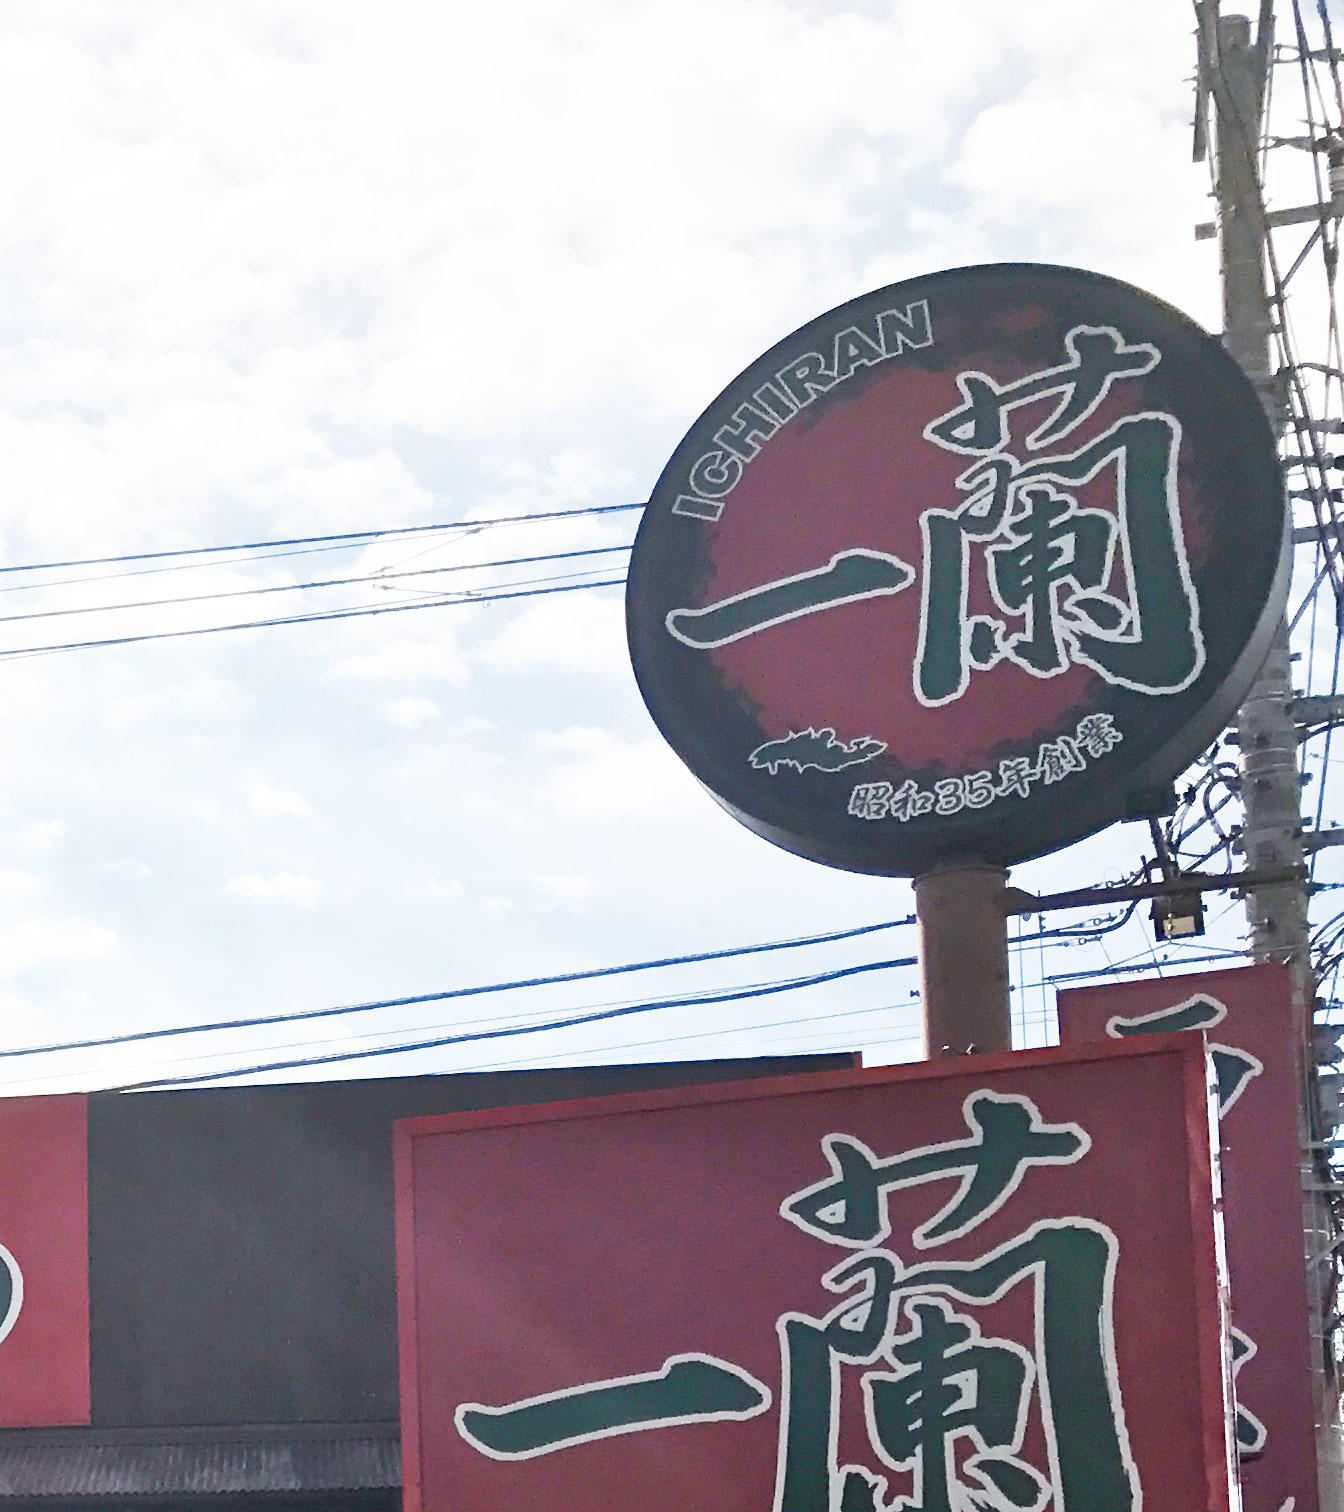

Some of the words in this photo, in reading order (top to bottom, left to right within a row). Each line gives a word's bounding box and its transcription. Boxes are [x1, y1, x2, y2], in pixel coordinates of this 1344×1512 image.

[666, 325, 1206, 708] 一蘭
[672, 300, 933, 521] ICHIRAN
[848, 713, 1123, 822] 昭和35年創業
